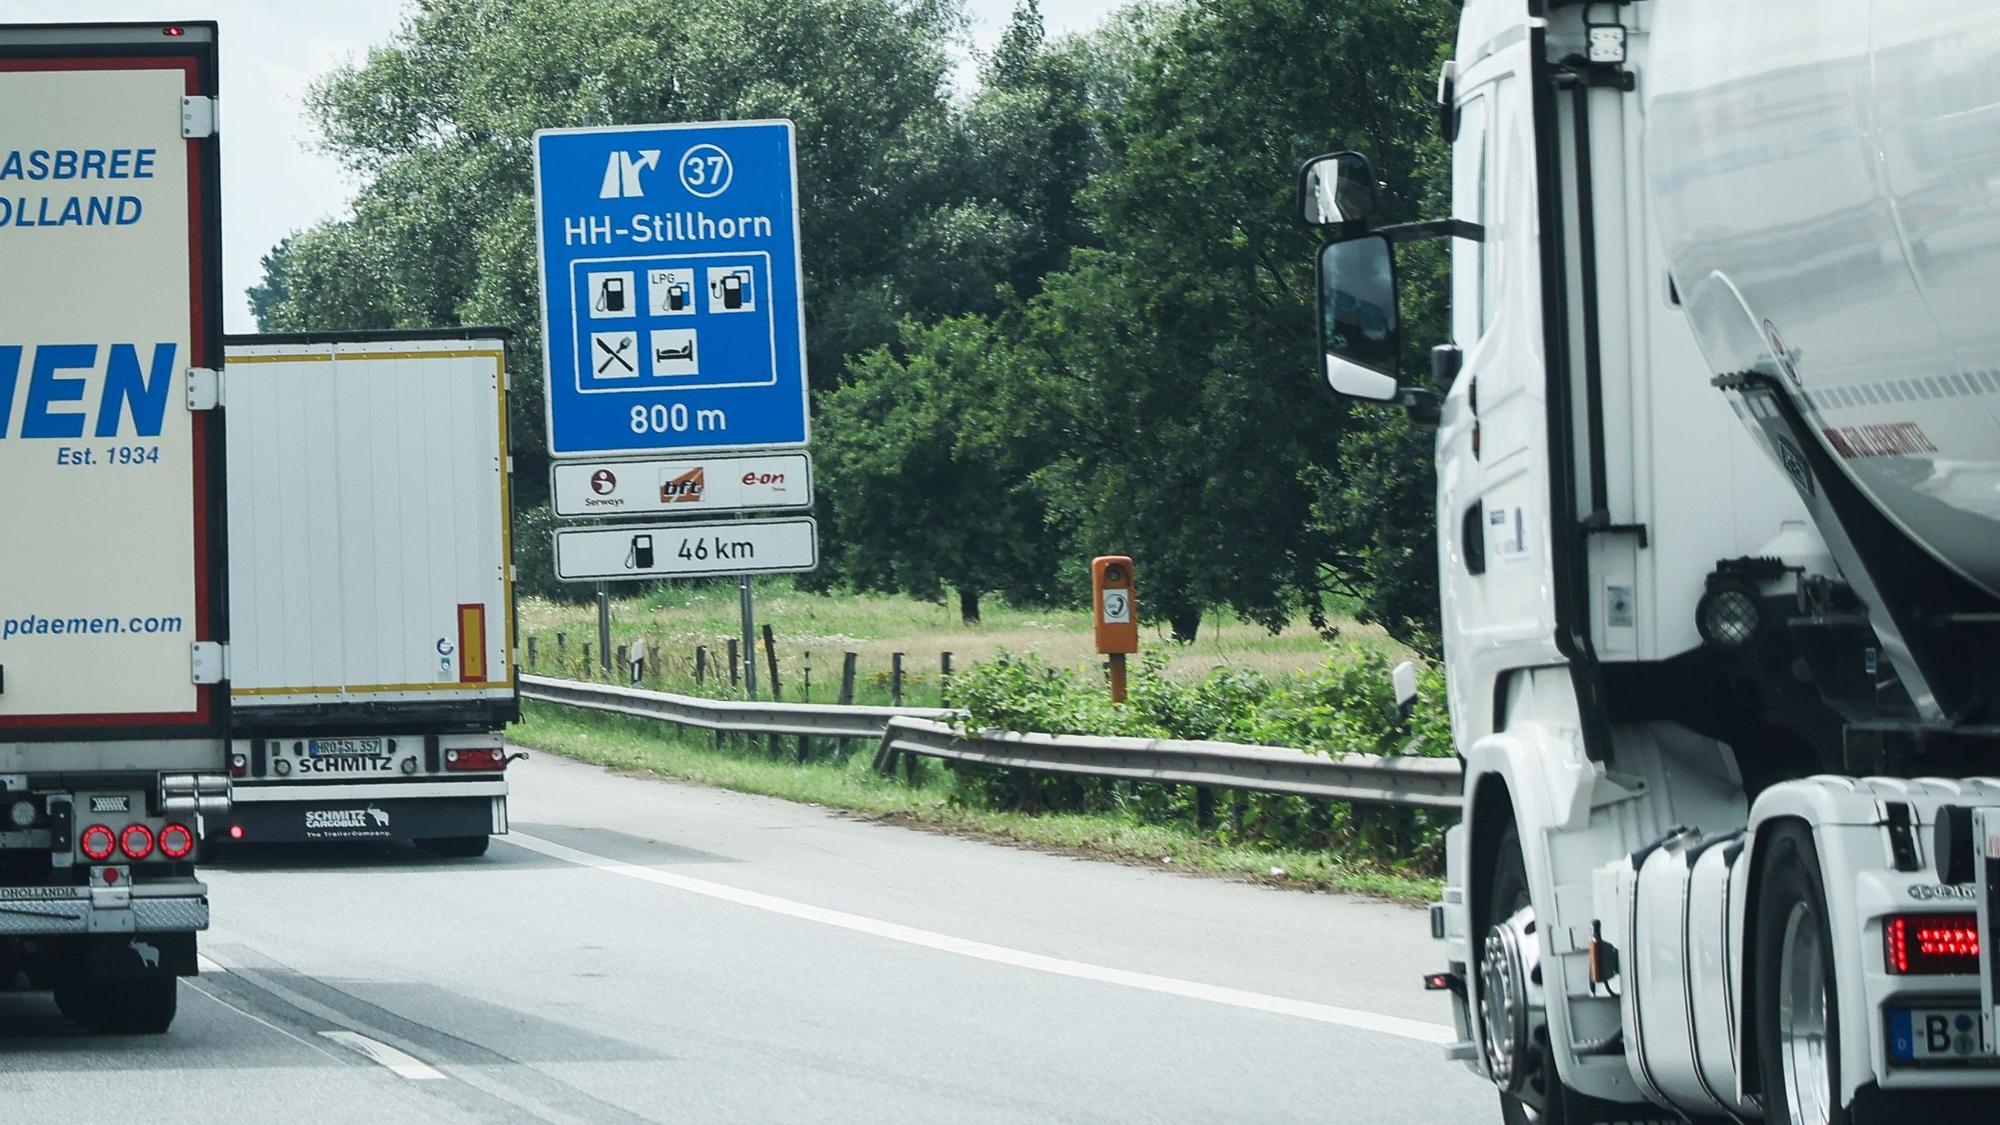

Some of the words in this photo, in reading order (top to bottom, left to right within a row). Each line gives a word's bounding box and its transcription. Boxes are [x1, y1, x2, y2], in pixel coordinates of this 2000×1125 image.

[0, 148, 157, 180] ASBREE
[687, 155, 724, 186] 37
[564, 211, 772, 246] HH-Stillhorn
[651, 273, 676, 285] LPG
[0, 343, 177, 439] EN
[630, 403, 689, 434] 800
[696, 408, 727, 431] m
[57, 447, 97, 465] Est.
[106, 446, 160, 465] 1934
[663, 479, 702, 497] bft
[678, 538, 708, 561] 46
[715, 537, 754, 560] km
[3, 614, 182, 640] pdaemen.com
[299, 756, 393, 773] SCHMITZ
[305, 810, 366, 821] SCHMITZ
[305, 819, 368, 828] CARGOBULL
[1, 887, 78, 898] DHOLLANDIA
[1926, 1014, 1952, 1054] B
